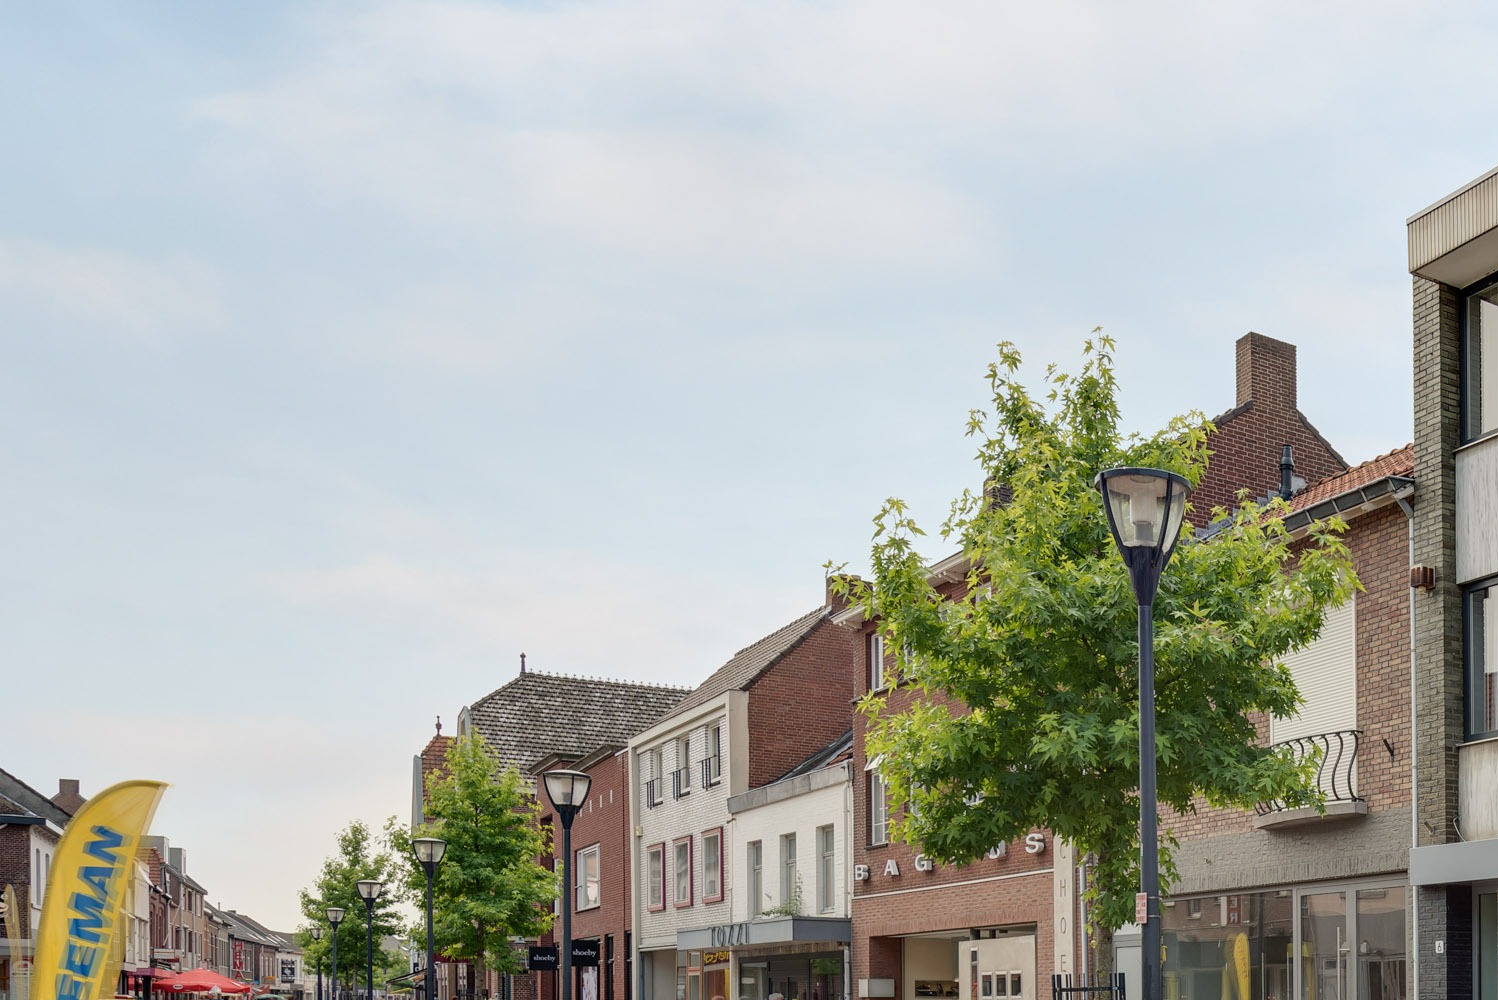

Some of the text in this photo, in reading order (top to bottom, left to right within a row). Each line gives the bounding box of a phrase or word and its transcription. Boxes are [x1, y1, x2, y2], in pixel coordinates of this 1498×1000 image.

[855, 833, 1047, 881] BAGUS
[709, 923, 750, 948] TOZZI
[1437, 942, 1442, 952] 6
[572, 948, 597, 957] shoeby
[533, 954, 556, 962] shoeby
